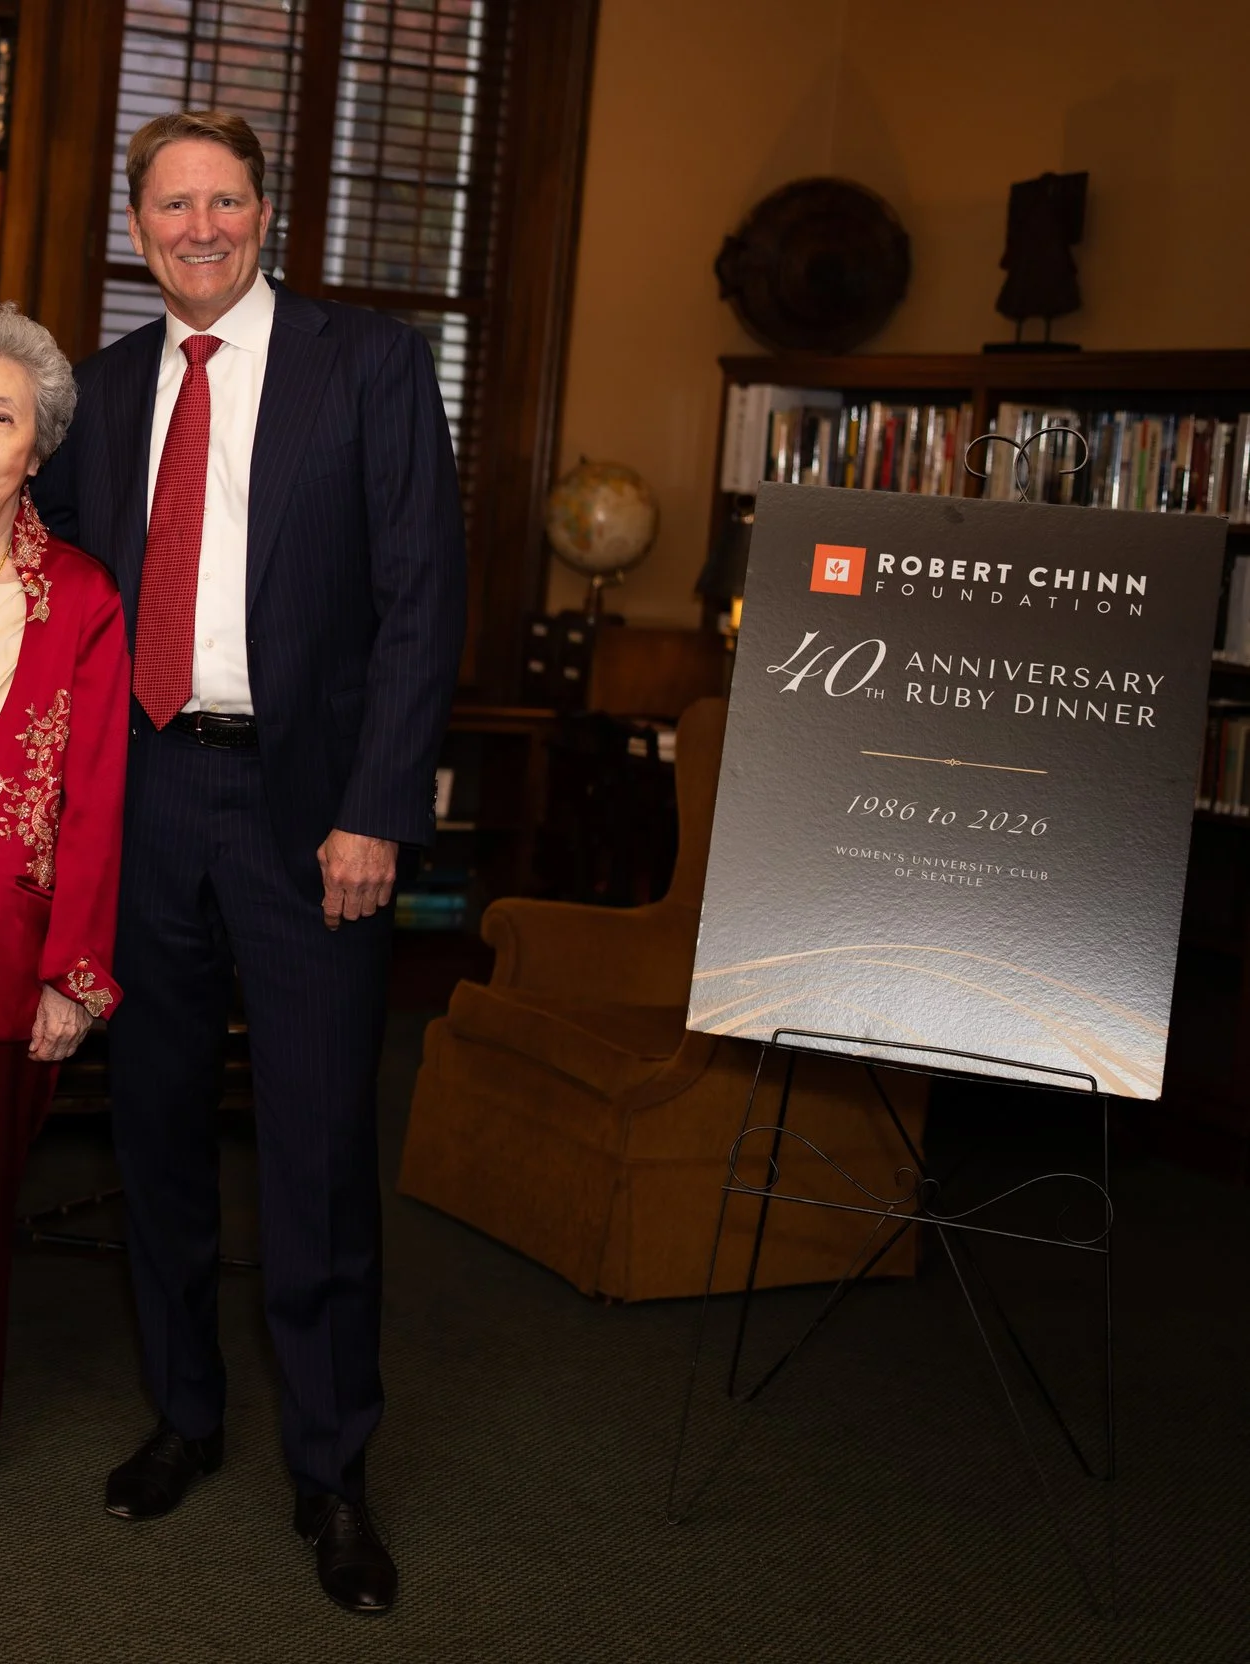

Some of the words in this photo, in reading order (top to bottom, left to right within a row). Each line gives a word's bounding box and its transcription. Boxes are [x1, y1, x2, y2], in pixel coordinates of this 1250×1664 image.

[877, 553, 1013, 584] ROBERT
[1028, 566, 1147, 596] CHINN
[875, 580, 1143, 617] FOUNDATION
[904, 651, 1165, 695] ANNIVERSARY
[906, 682, 995, 710] RUBY
[1014, 693, 1156, 728] DINNER
[846, 794, 919, 821] 1986
[927, 806, 957, 826] to
[967, 809, 1050, 837] 2026
[835, 845, 905, 863] WOMEN'S
[912, 855, 1003, 875] UNIVERSITY
[1009, 867, 1048, 881] CLUB
[894, 867, 914, 878] OF
[920, 870, 983, 887] SEATTLE
